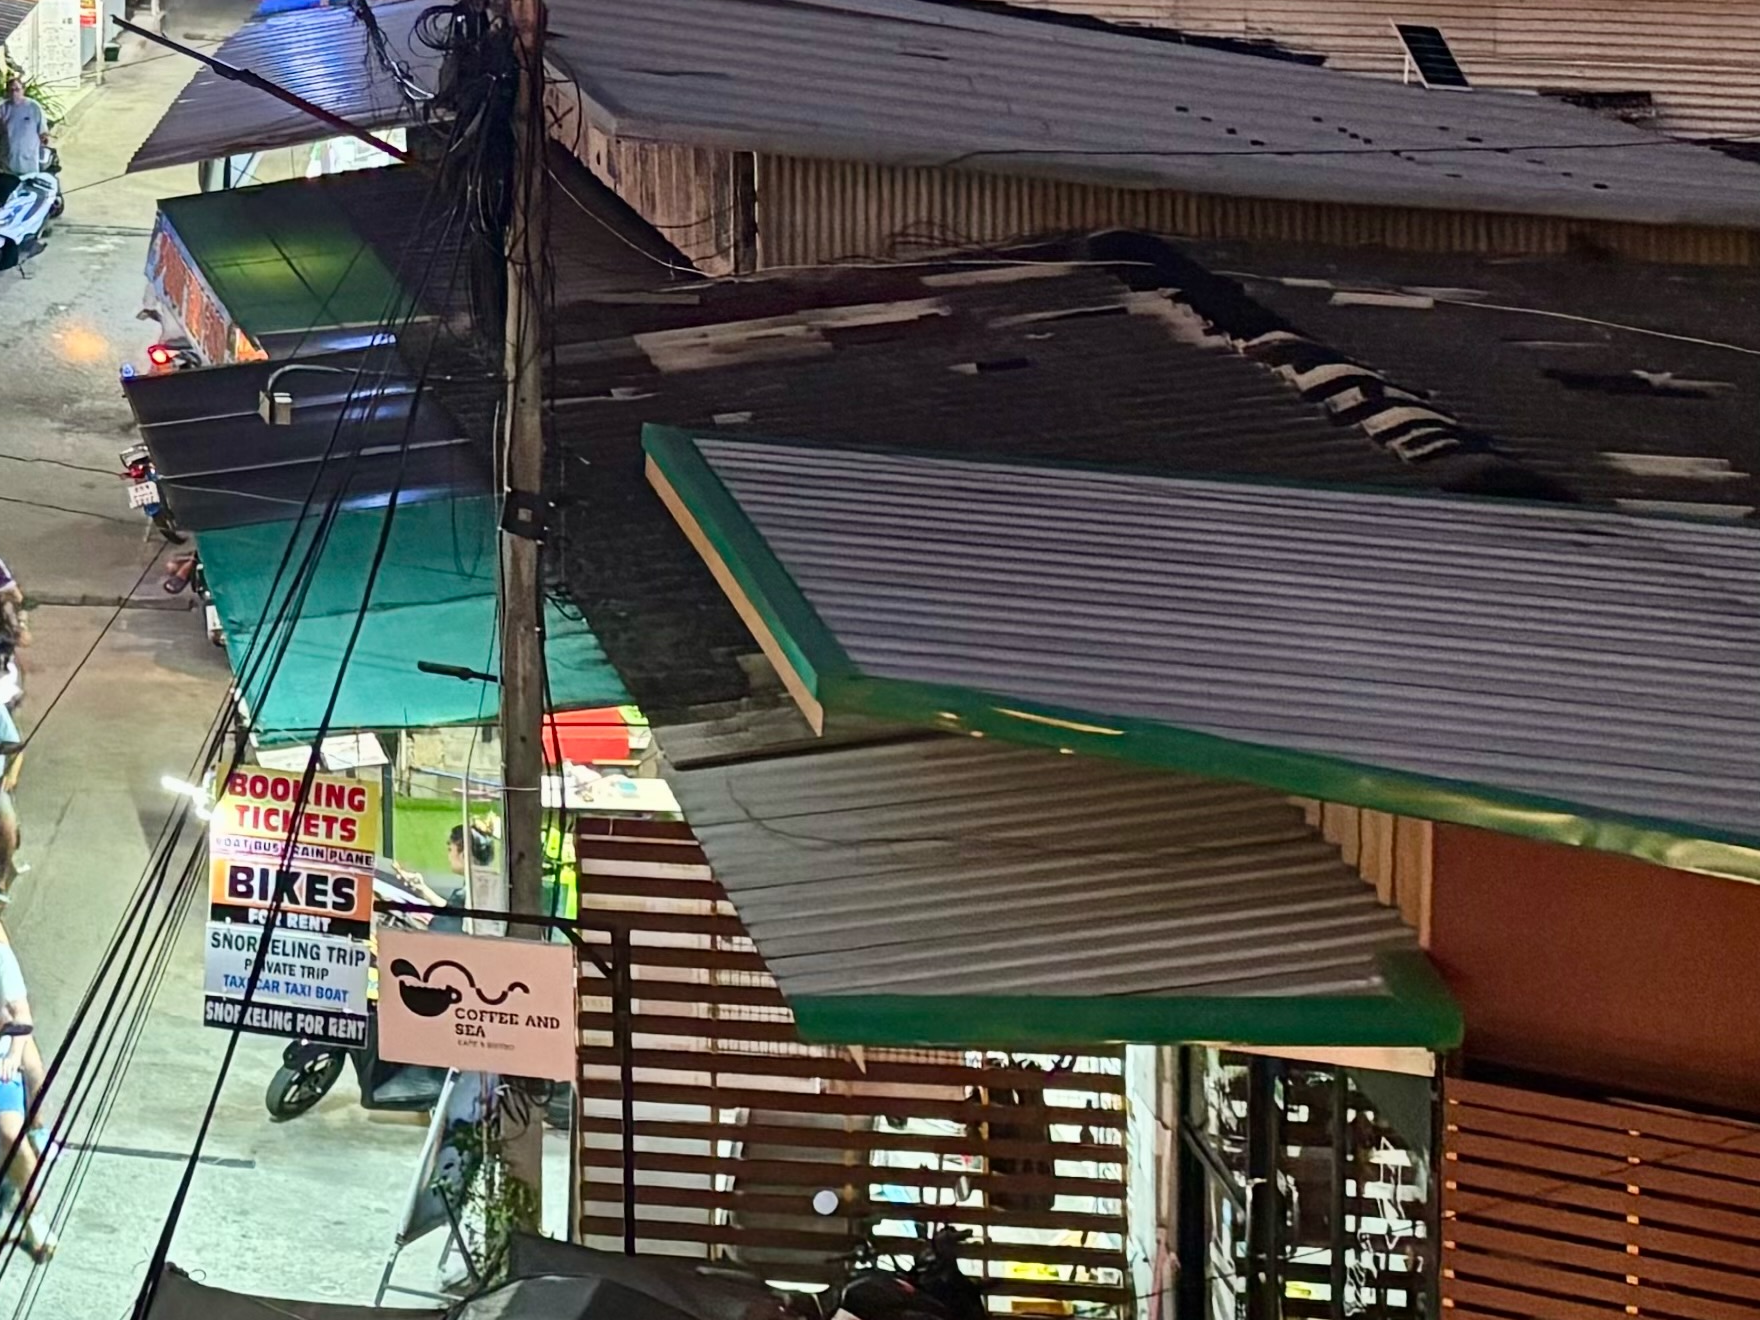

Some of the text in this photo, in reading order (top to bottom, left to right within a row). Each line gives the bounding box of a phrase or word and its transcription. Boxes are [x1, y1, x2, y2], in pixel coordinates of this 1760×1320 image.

[330, 849, 374, 867] PLANE
[230, 865, 356, 913] BIKES
[286, 912, 332, 932] RENT
[211, 931, 366, 968] SNORELING TRIP
[244, 958, 330, 981] PIVATE TRIP
[224, 974, 249, 989] TAX
[284, 981, 312, 997] TAXI
[315, 986, 349, 1003] BOAT
[296, 1013, 325, 1036] FOR
[328, 1016, 366, 1041] RENT
[455, 1008, 560, 1029] COFFEE AND
[455, 1023, 486, 1038] SEA
